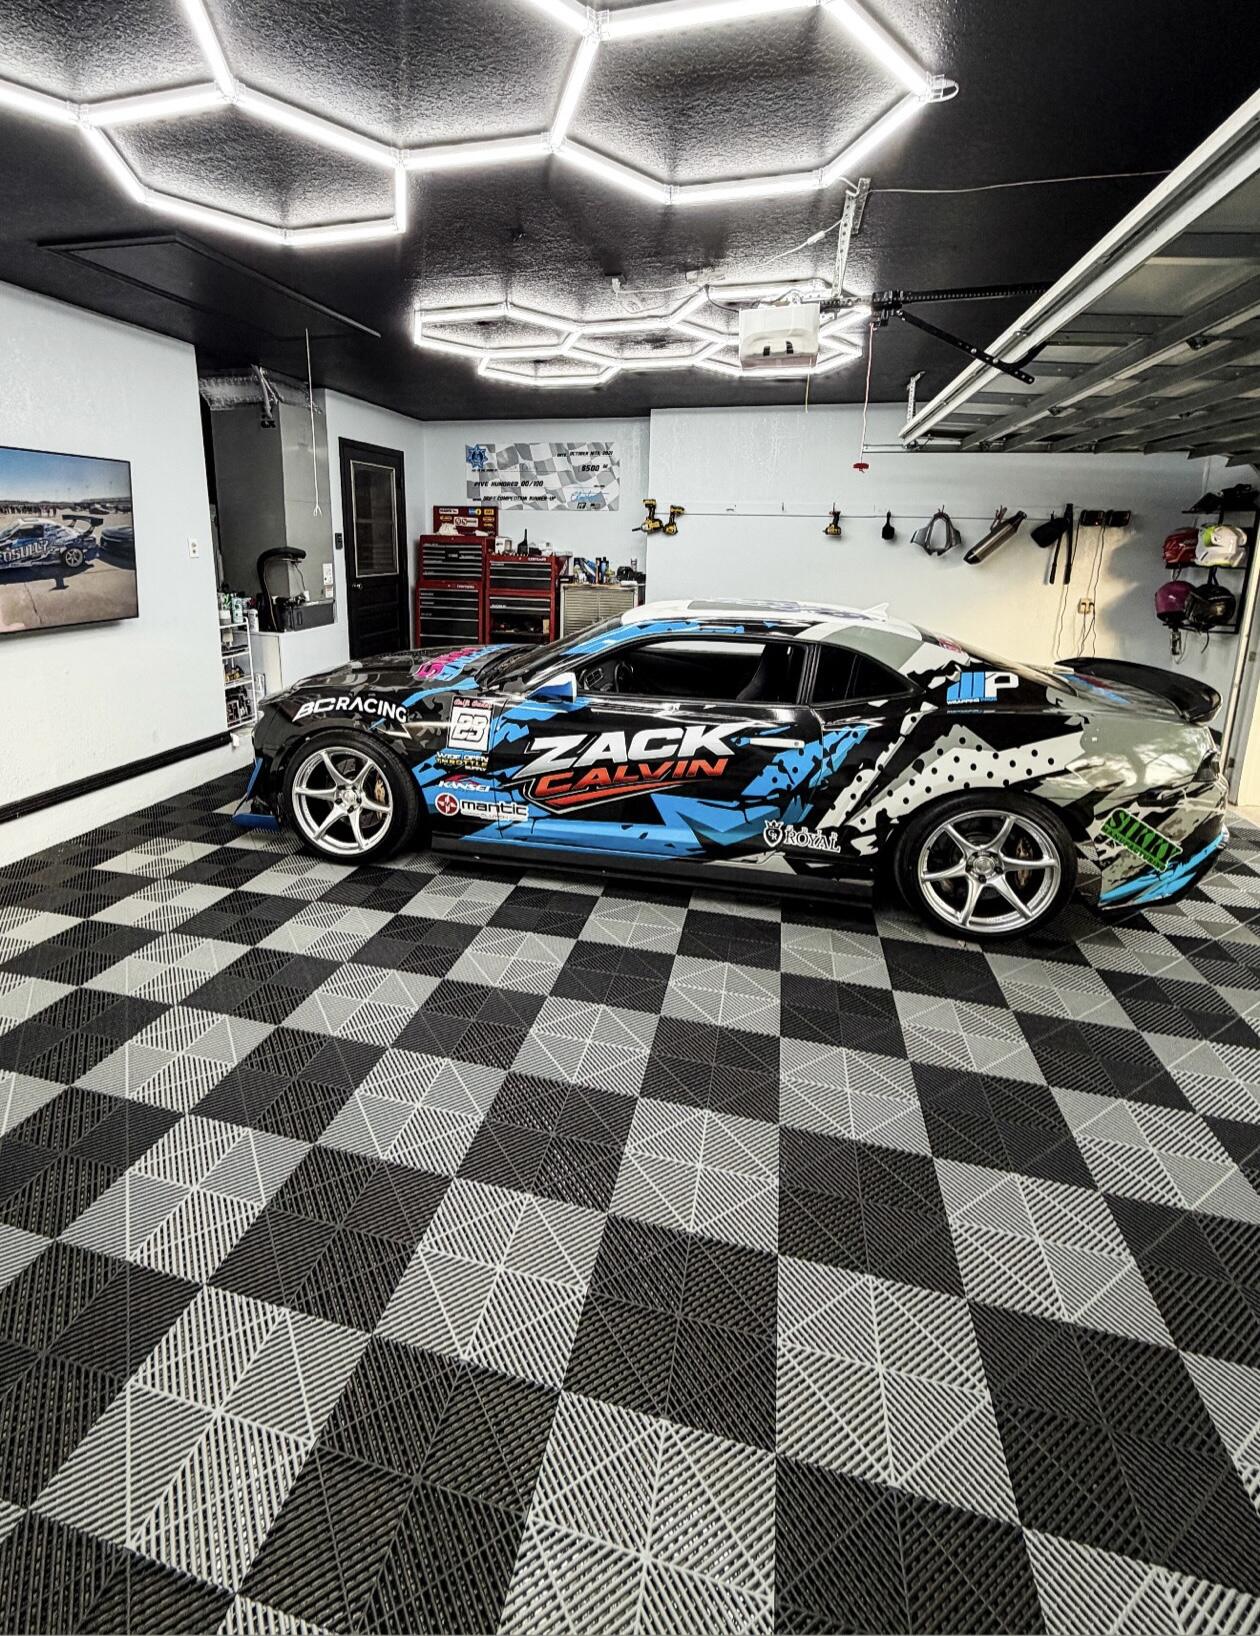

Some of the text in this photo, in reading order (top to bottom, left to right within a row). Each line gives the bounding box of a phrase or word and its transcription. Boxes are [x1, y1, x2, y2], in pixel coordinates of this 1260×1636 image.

[512, 722, 746, 780] ZACK
[438, 780, 490, 793] KANSEI
[535, 758, 729, 797] CALVIN
[461, 800, 527, 816] mantic
[784, 828, 841, 853] ROYAL
[1106, 809, 1181, 864] SIKKY
